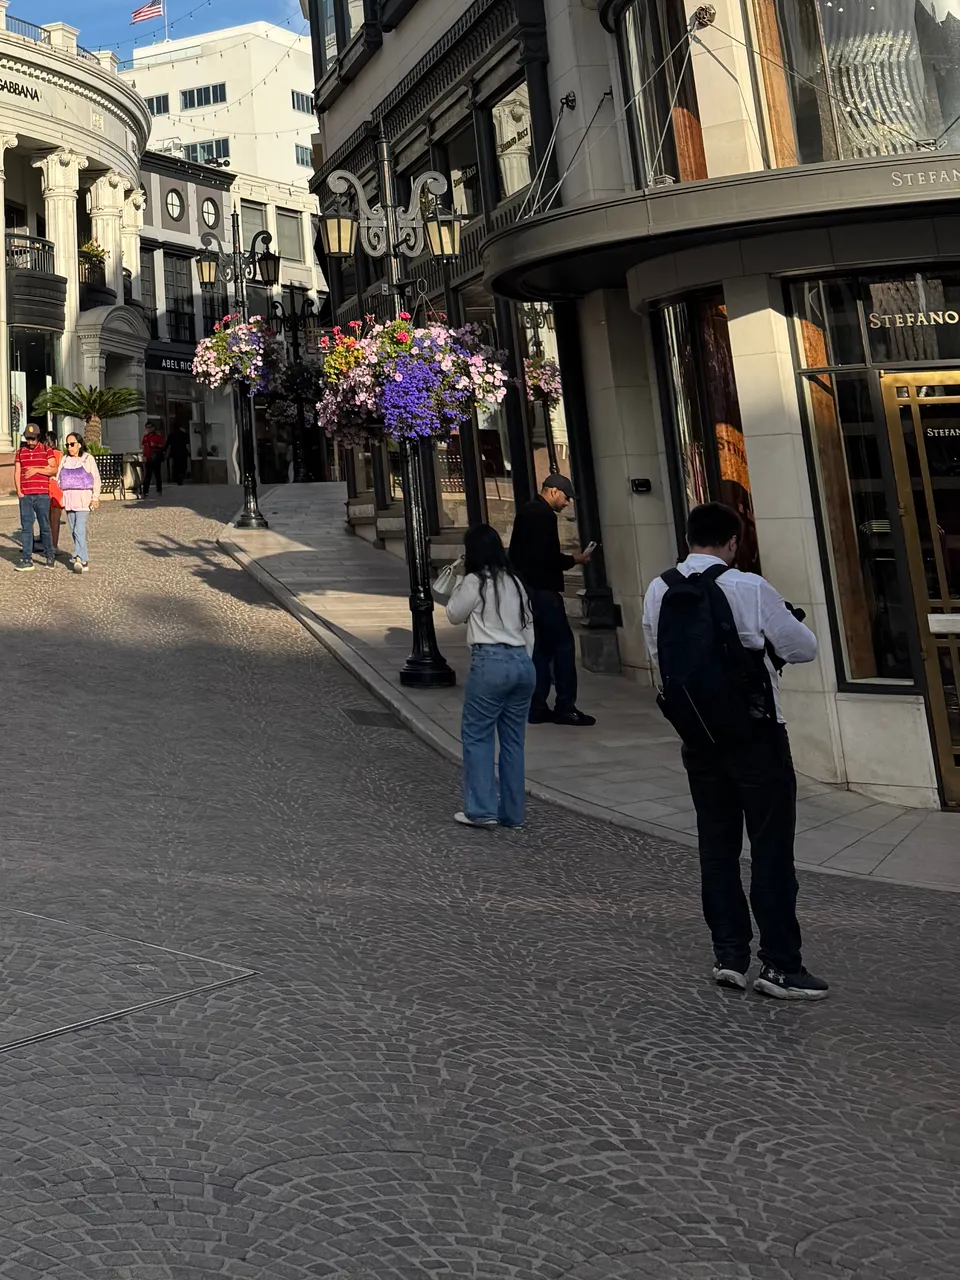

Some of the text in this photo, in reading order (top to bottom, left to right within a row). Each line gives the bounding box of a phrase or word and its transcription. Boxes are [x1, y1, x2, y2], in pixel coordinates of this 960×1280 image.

[891, 169, 960, 187] STEFAN
[869, 310, 960, 329] STEFANO
[161, 358, 179, 369] ABEL
